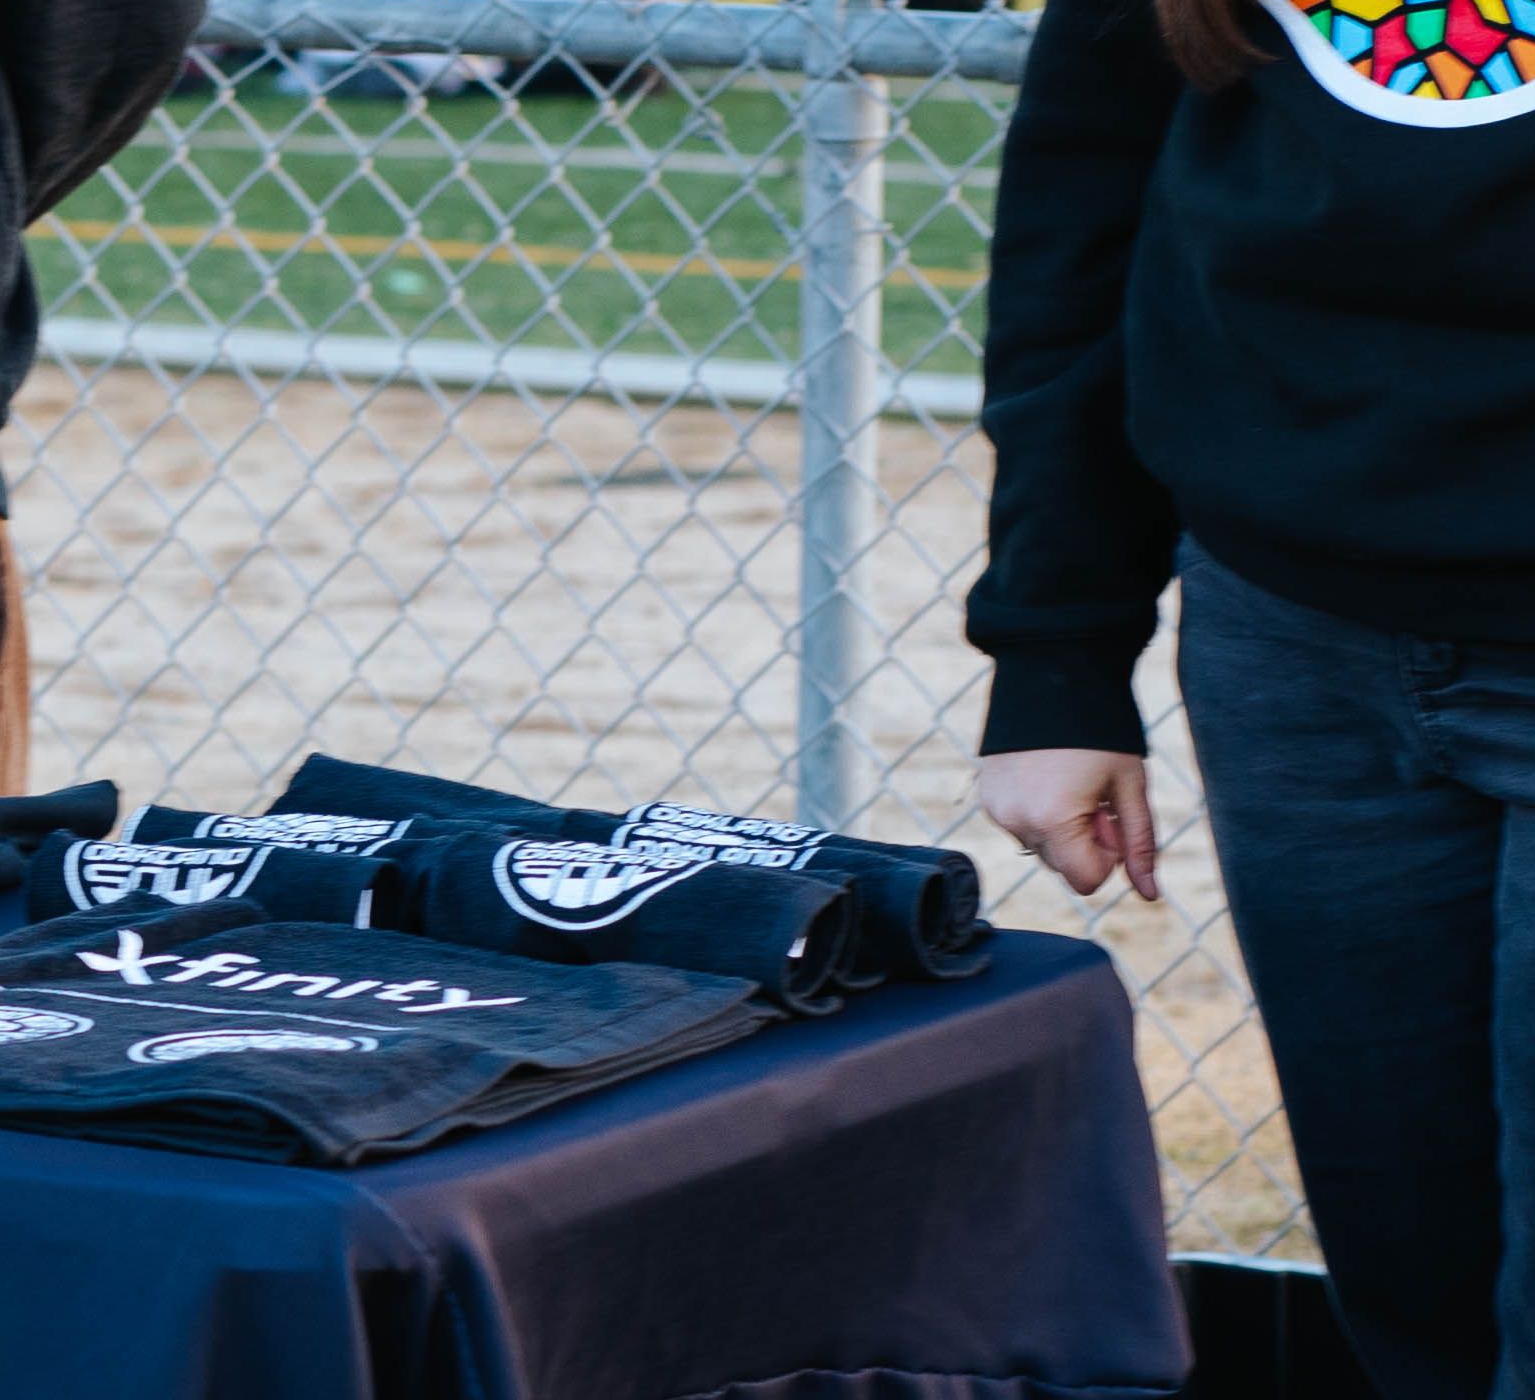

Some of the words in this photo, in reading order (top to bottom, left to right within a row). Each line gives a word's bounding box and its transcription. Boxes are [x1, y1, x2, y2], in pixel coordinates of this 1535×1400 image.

[647, 806, 811, 842] OAKLAND
[82, 843, 253, 865] OAKLAND
[512, 847, 692, 869] OAKLAND
[512, 861, 669, 909] SOUL
